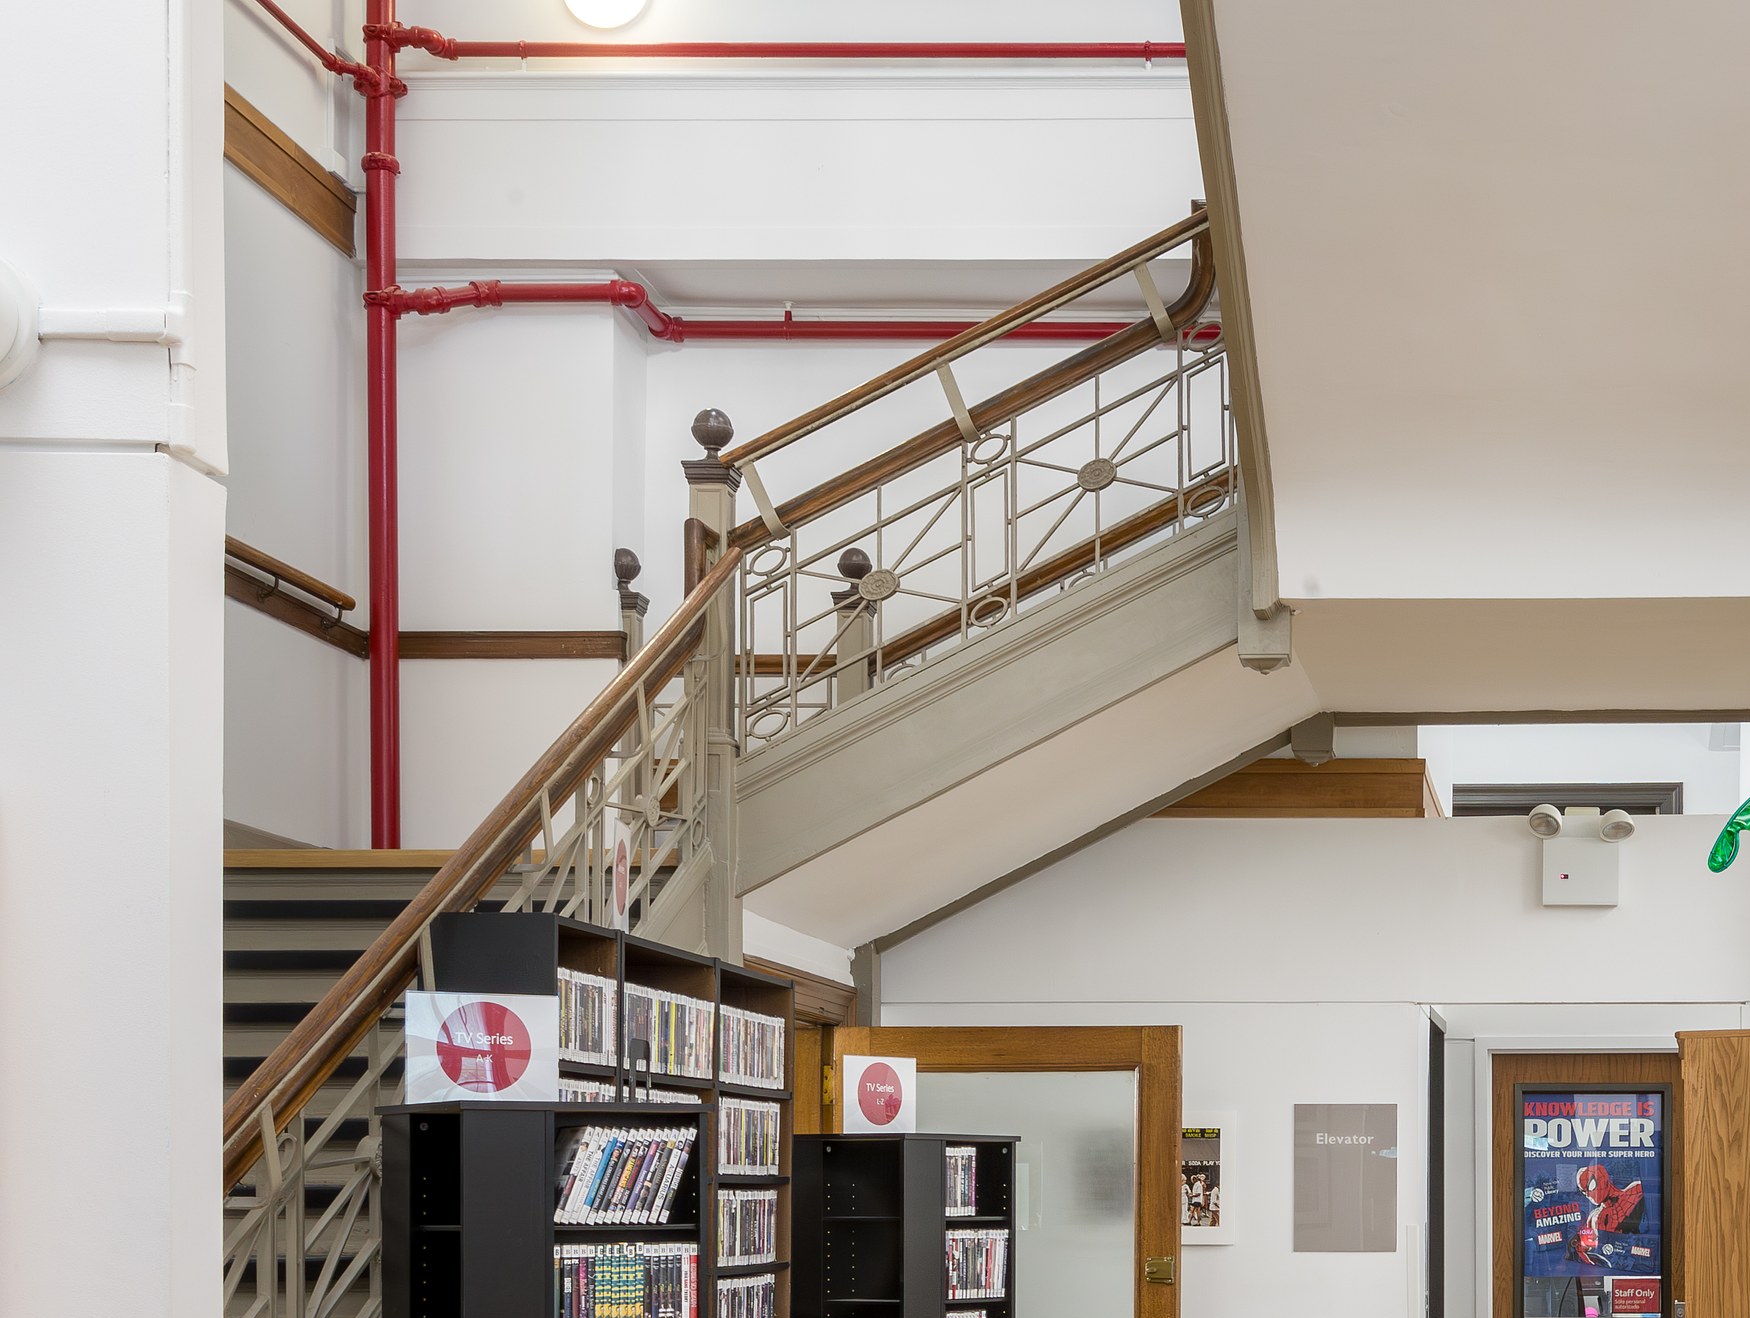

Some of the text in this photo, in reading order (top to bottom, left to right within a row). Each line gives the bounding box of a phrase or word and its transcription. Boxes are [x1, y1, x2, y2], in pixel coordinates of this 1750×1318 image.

[455, 1032, 513, 1045] TV Series
[476, 1054, 493, 1064] A-K
[866, 1083, 895, 1093] TV Series
[1524, 1102, 1655, 1116] KNOWLEDGE IS
[1316, 1133, 1374, 1145] Elevator
[1524, 1118, 1655, 1148] POWER
[1534, 1202, 1580, 1219] BEYOND
[1536, 1212, 1582, 1228] AMAZING
[1538, 1232, 1562, 1245] MARVEL
[1631, 1246, 1651, 1257] MARVEL
[1614, 1288, 1655, 1299] Staff Only
